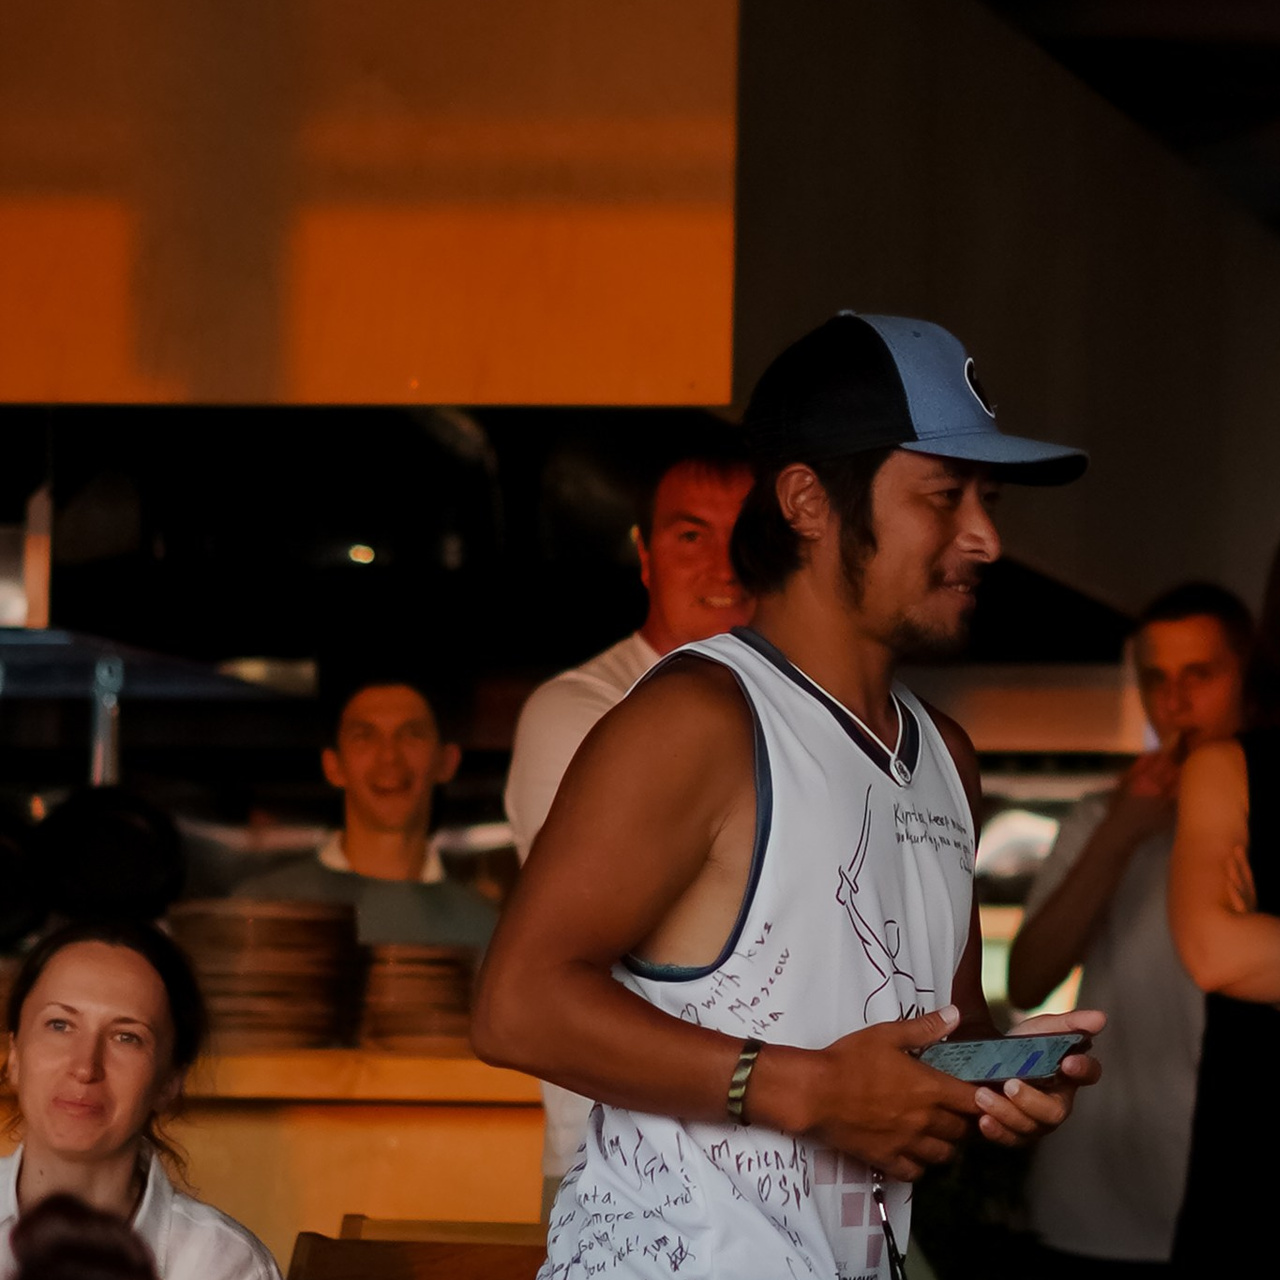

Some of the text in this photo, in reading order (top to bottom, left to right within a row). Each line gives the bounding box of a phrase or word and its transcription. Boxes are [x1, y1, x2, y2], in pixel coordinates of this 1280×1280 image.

[702, 969, 740, 1011] with
[728, 947, 790, 1023] Moscow
[735, 1138, 808, 1175] Friends
